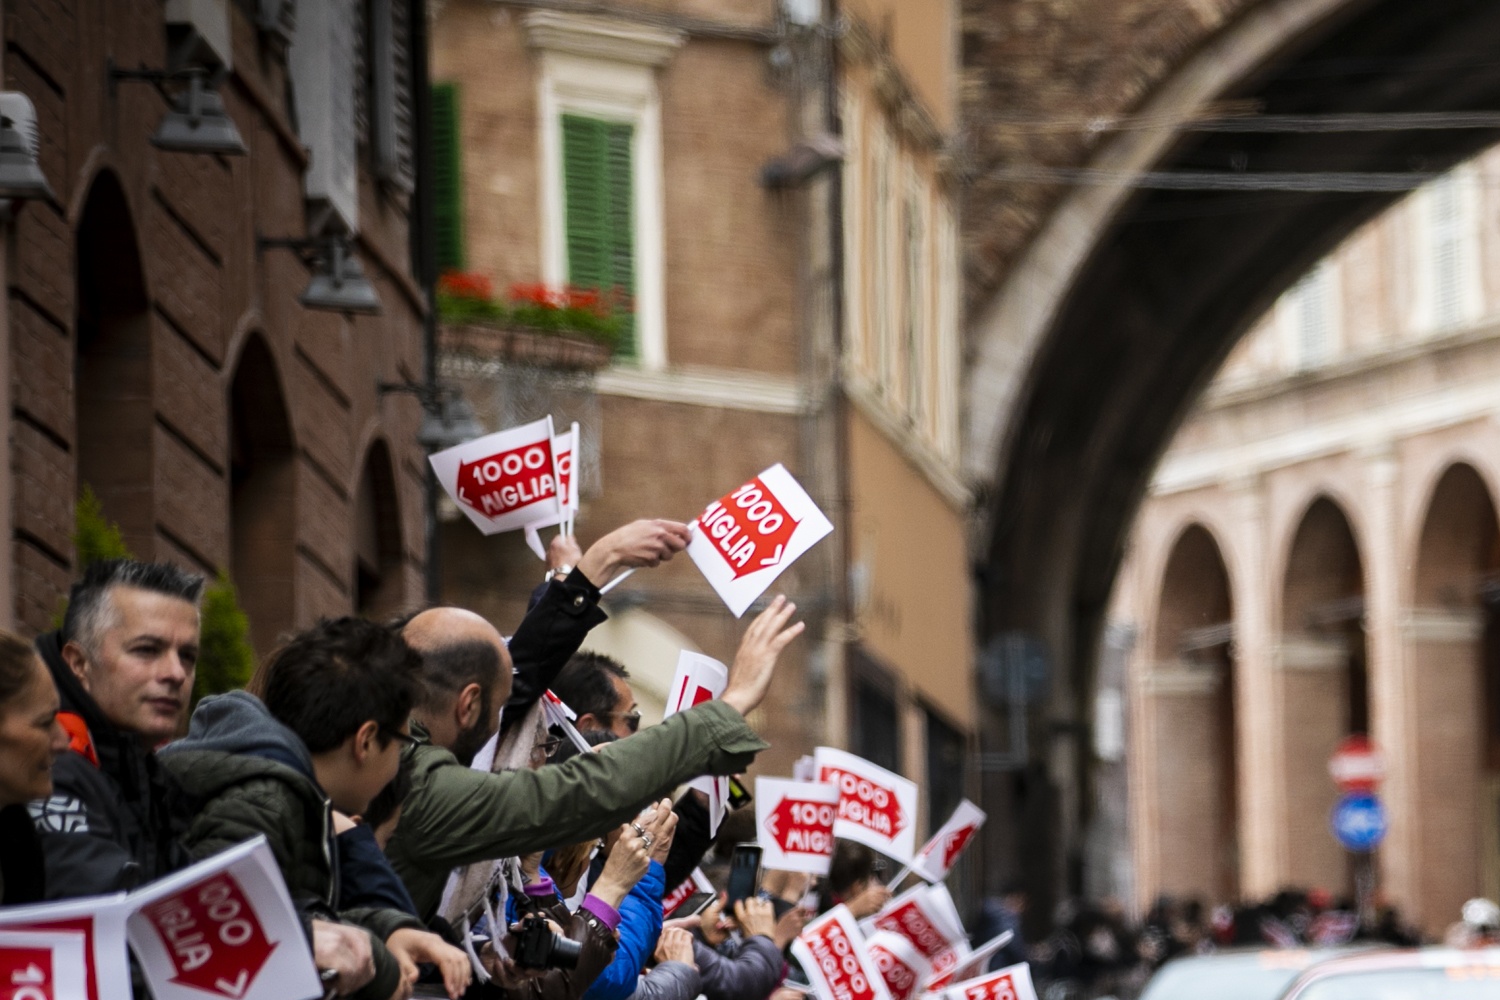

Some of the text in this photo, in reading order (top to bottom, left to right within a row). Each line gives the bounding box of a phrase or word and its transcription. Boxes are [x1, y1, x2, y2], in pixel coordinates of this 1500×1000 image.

[473, 447, 545, 486] 1000
[731, 483, 783, 535] 1000
[790, 802, 833, 827] 100
[839, 798, 891, 833] IGLIA
[199, 880, 253, 946] 000
[827, 924, 867, 994] 1000
